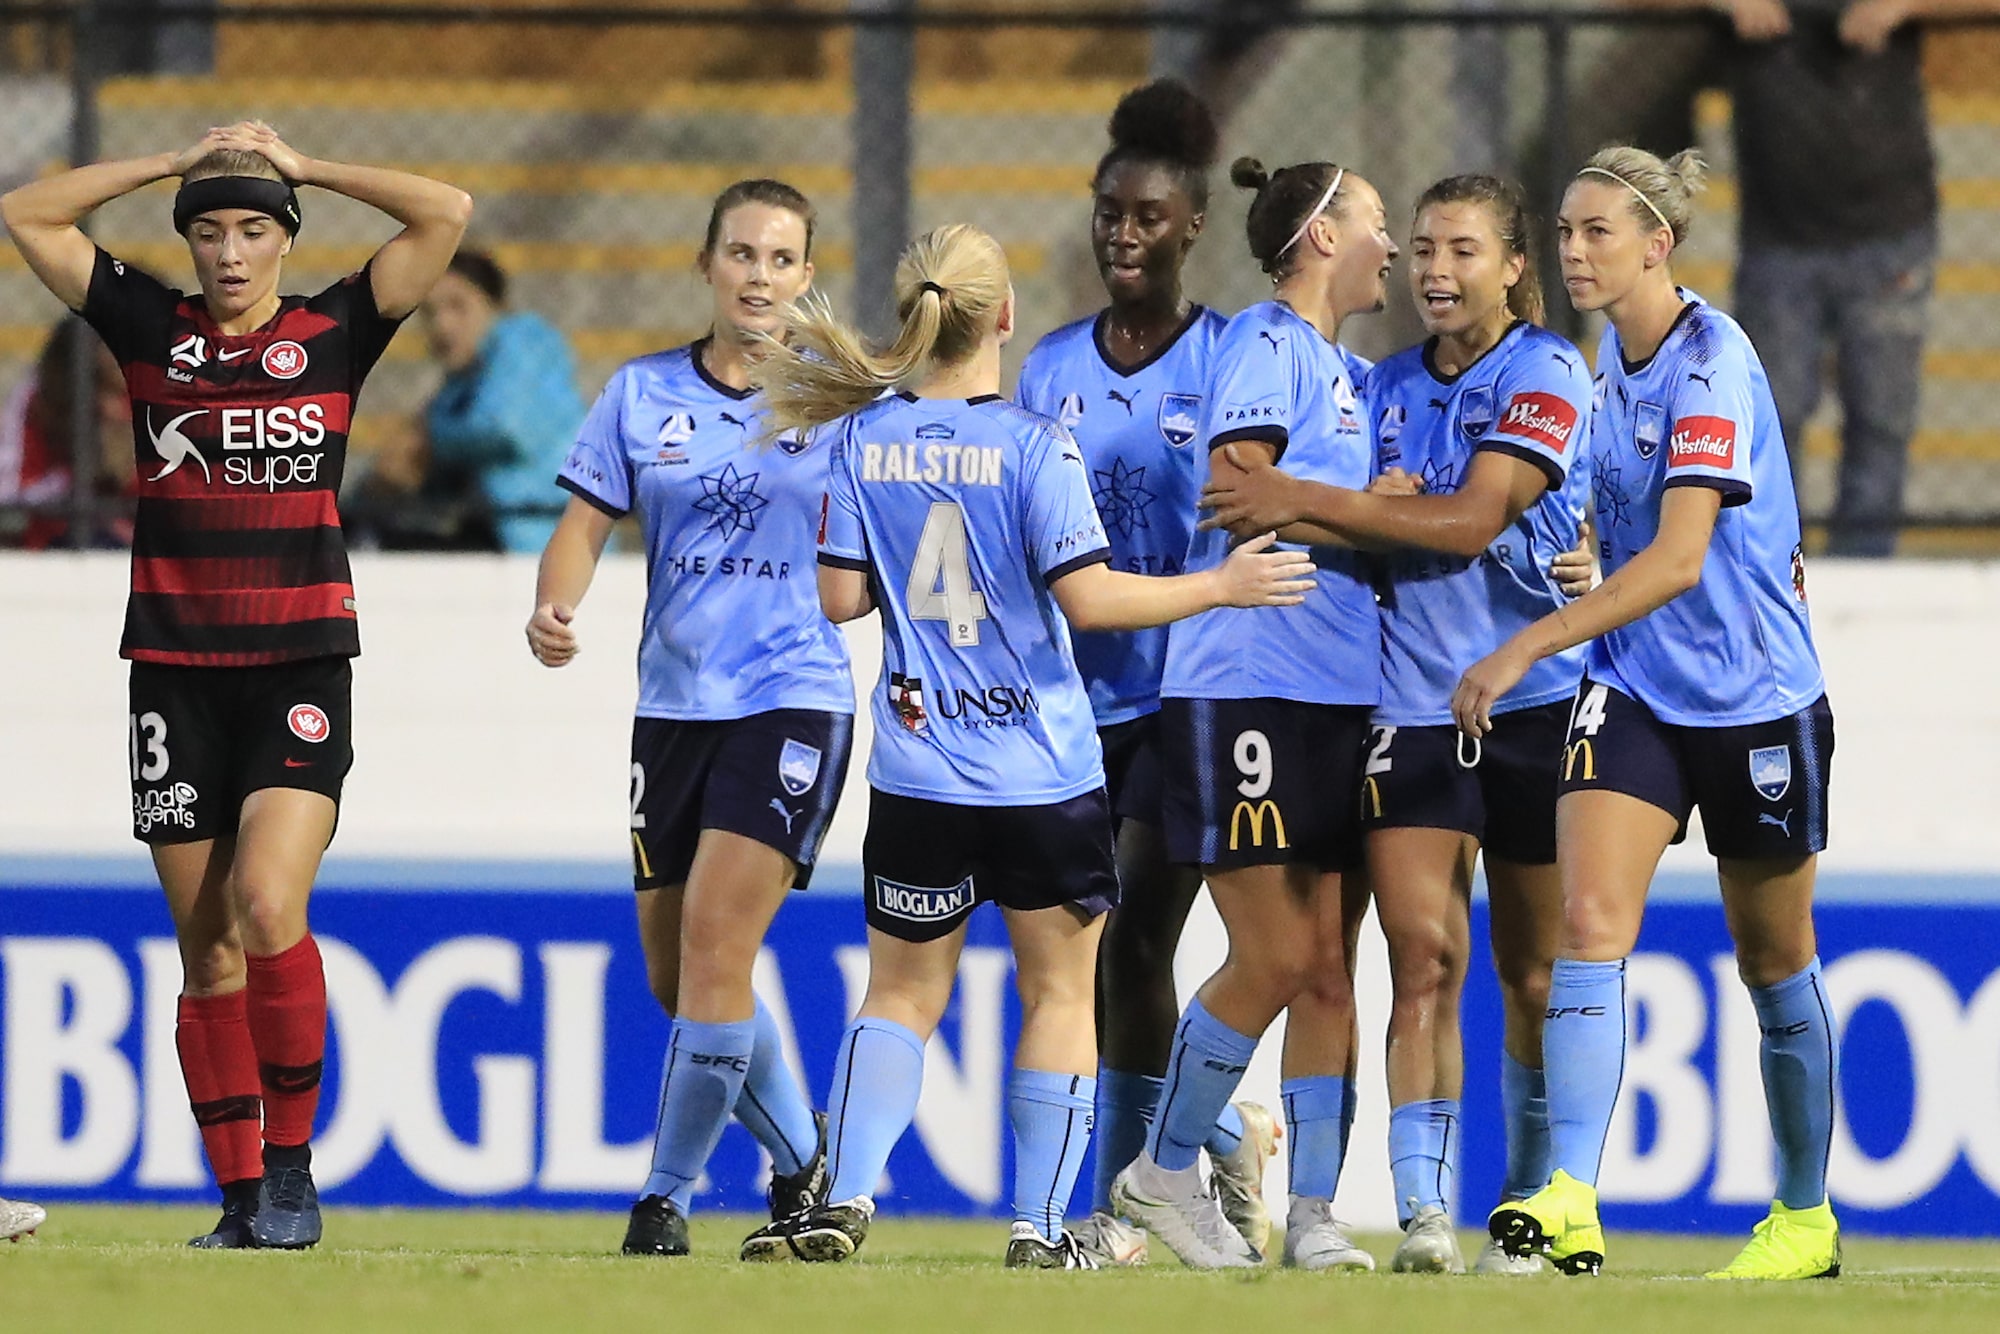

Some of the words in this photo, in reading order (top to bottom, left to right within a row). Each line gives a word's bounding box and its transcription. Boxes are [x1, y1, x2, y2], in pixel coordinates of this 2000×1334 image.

[222, 403, 325, 450] EISS
[1506, 402, 1572, 442] Westfield
[224, 452, 325, 493] super
[862, 443, 1003, 487] RALSTON
[720, 557, 790, 580] STAR
[907, 501, 986, 646] 4
[936, 687, 1040, 719] UNSW
[964, 717, 1029, 730] SYDNEY
[1233, 729, 1274, 799] 9
[883, 884, 963, 915] BIOGLAN
[1545, 1006, 1606, 1018] SFC
[691, 1053, 748, 1073] SFC
[1600, 946, 2000, 1211] BIO
